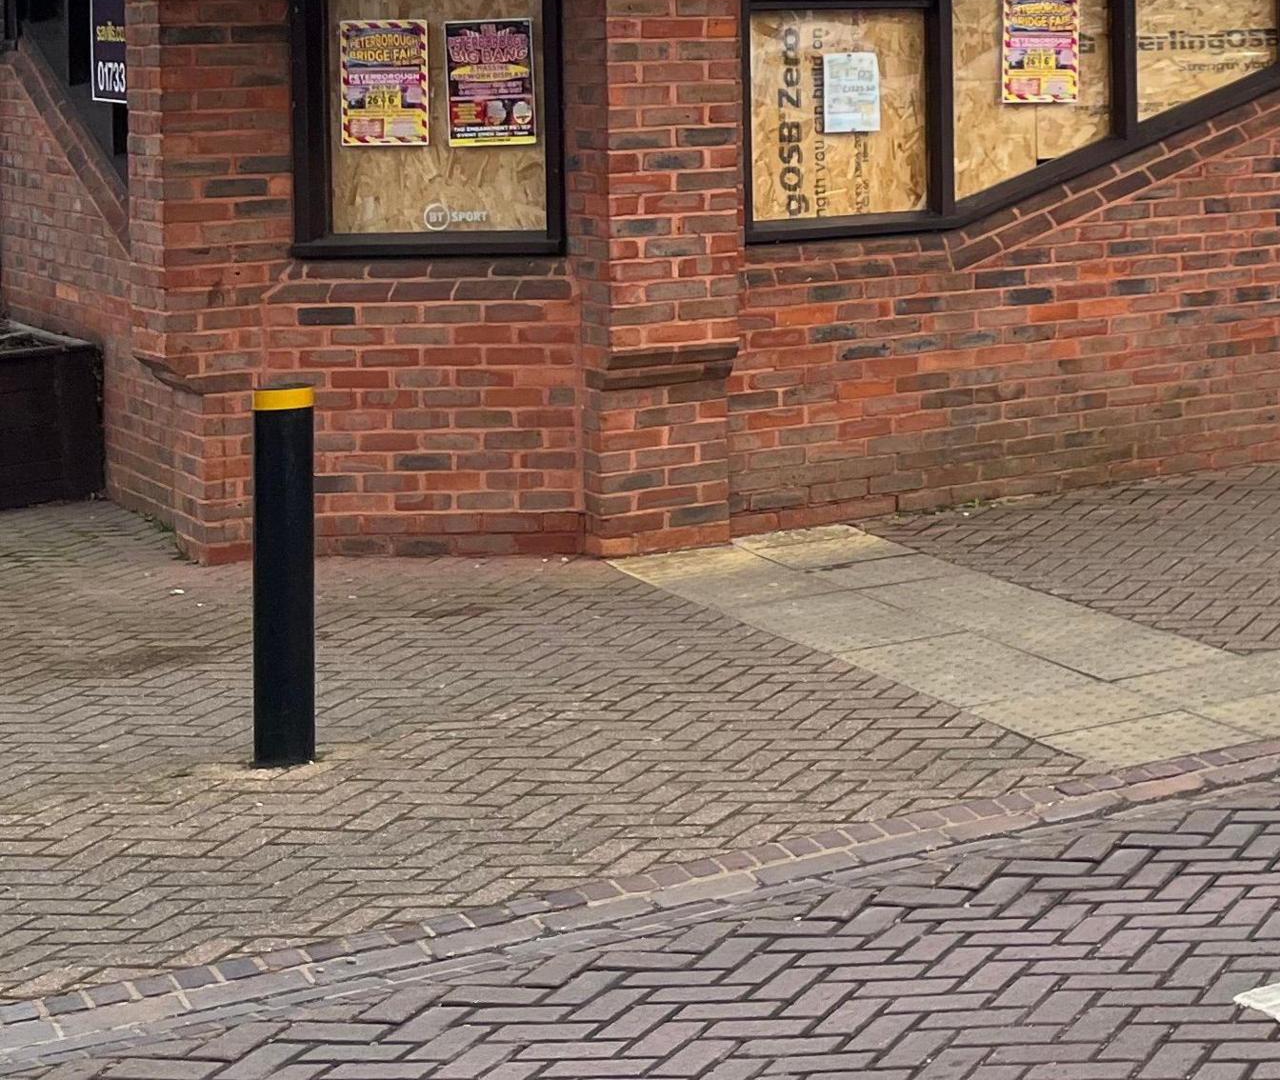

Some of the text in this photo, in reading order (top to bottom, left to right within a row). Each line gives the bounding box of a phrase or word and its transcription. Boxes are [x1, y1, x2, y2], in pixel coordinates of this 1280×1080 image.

[349, 34, 420, 49] PETERBOROUGH
[811, 27, 823, 50] on
[349, 49, 390, 61] BRIDGE
[481, 46, 528, 63] BANG
[777, 26, 803, 110] Zero
[97, 61, 126, 93] 01733
[349, 72, 420, 81] PETERBOROUGH
[811, 54, 825, 104] build
[367, 95, 379, 105] 26
[813, 105, 825, 135] can
[428, 211, 444, 222] BT
[450, 210, 488, 222] SPORT
